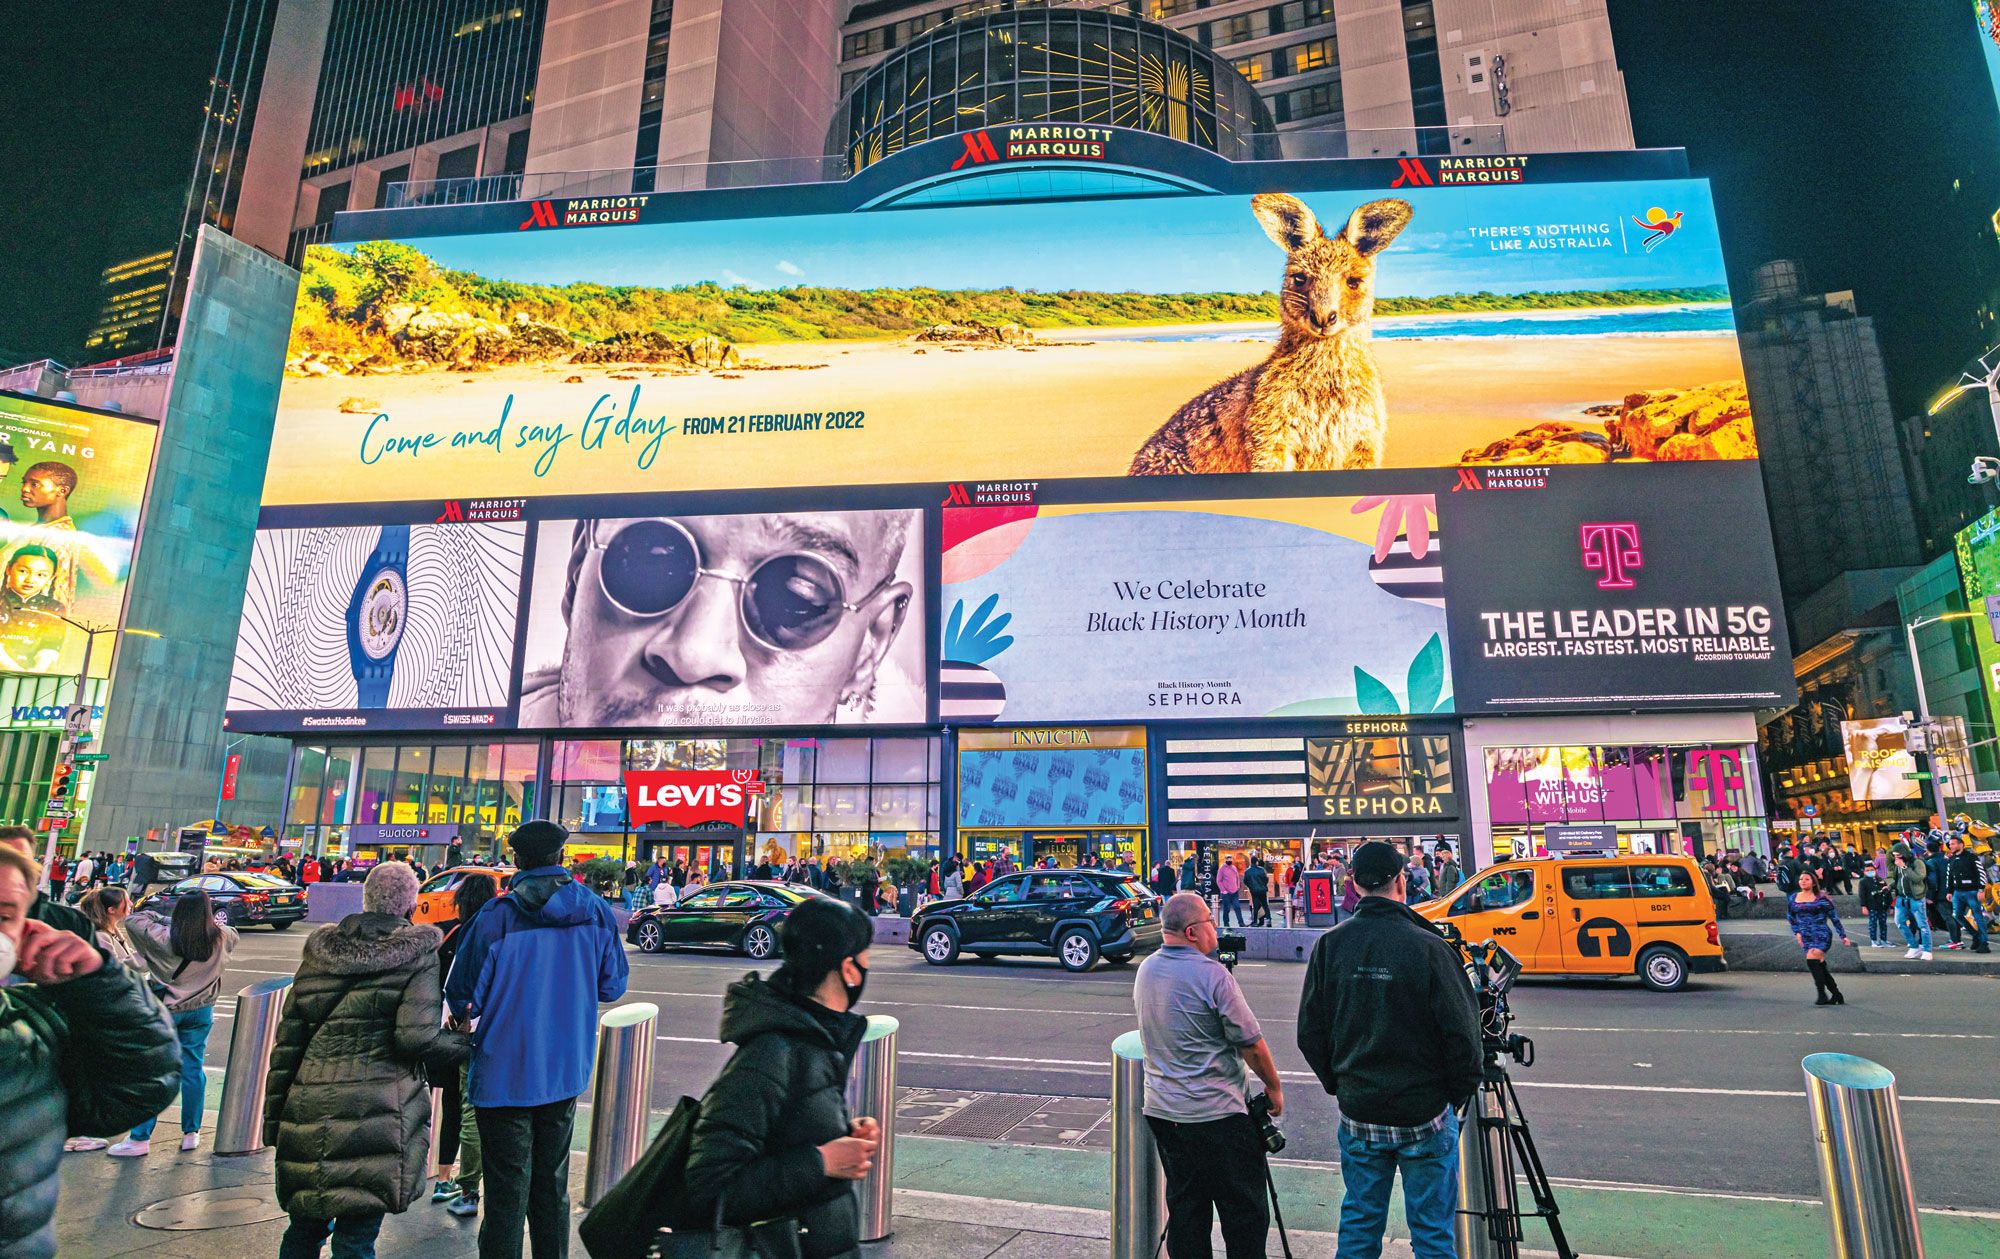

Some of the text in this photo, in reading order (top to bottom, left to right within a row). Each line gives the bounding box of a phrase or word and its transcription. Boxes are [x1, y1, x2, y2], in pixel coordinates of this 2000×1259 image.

[1010, 128, 1112, 141] MARRIOTT
[1010, 143, 1101, 156] MARQUIS
[1440, 156, 1528, 169] MARRIOTT
[1442, 170, 1519, 182] MARQUIS
[568, 196, 648, 210] MARRIOTT
[567, 210, 637, 224] MARQUIS
[1469, 224, 1610, 237] THERE'S NOTHING
[1491, 237, 1612, 250] LIKE AUSTRALIA
[360, 384, 865, 477] Come and say G'day FROM 21 FEBRUARY 2022
[27, 437, 95, 459] YANG
[1488, 468, 1550, 478] MARRIOTT
[977, 482, 1039, 492] MARRIOTT
[1488, 479, 1544, 488] MARQUIS
[470, 500, 527, 509] MARRIOTT
[977, 494, 1031, 503] MARQUIS
[469, 510, 519, 519] MARQUIS
[1114, 579, 1267, 601] We Celebrate
[1086, 608, 1308, 635] Black History Month
[1481, 606, 1771, 640] THE LEADER IN 5G
[1484, 636, 1775, 658] LARGEST. FASTEST. MOST RELIABLE.
[1695, 653, 1733, 661] ACCORDING
[1744, 652, 1771, 660] UMLAUT
[1179, 682, 1206, 690] History
[1148, 692, 1242, 706] SEPHORA
[686, 703, 726, 714] probably
[303, 716, 367, 726] #SwatchxHodinkee
[1347, 722, 1408, 733] SEPHORA
[1012, 730, 1091, 745] INVICTA
[1539, 778, 1568, 791] ARE
[1535, 790, 1608, 805] WITH US?
[1325, 796, 1442, 816] SEPHORA
[379, 828, 420, 838] swatch
[1203, 846, 1212, 893] SEPHORA
[1493, 927, 1517, 936] NYC
